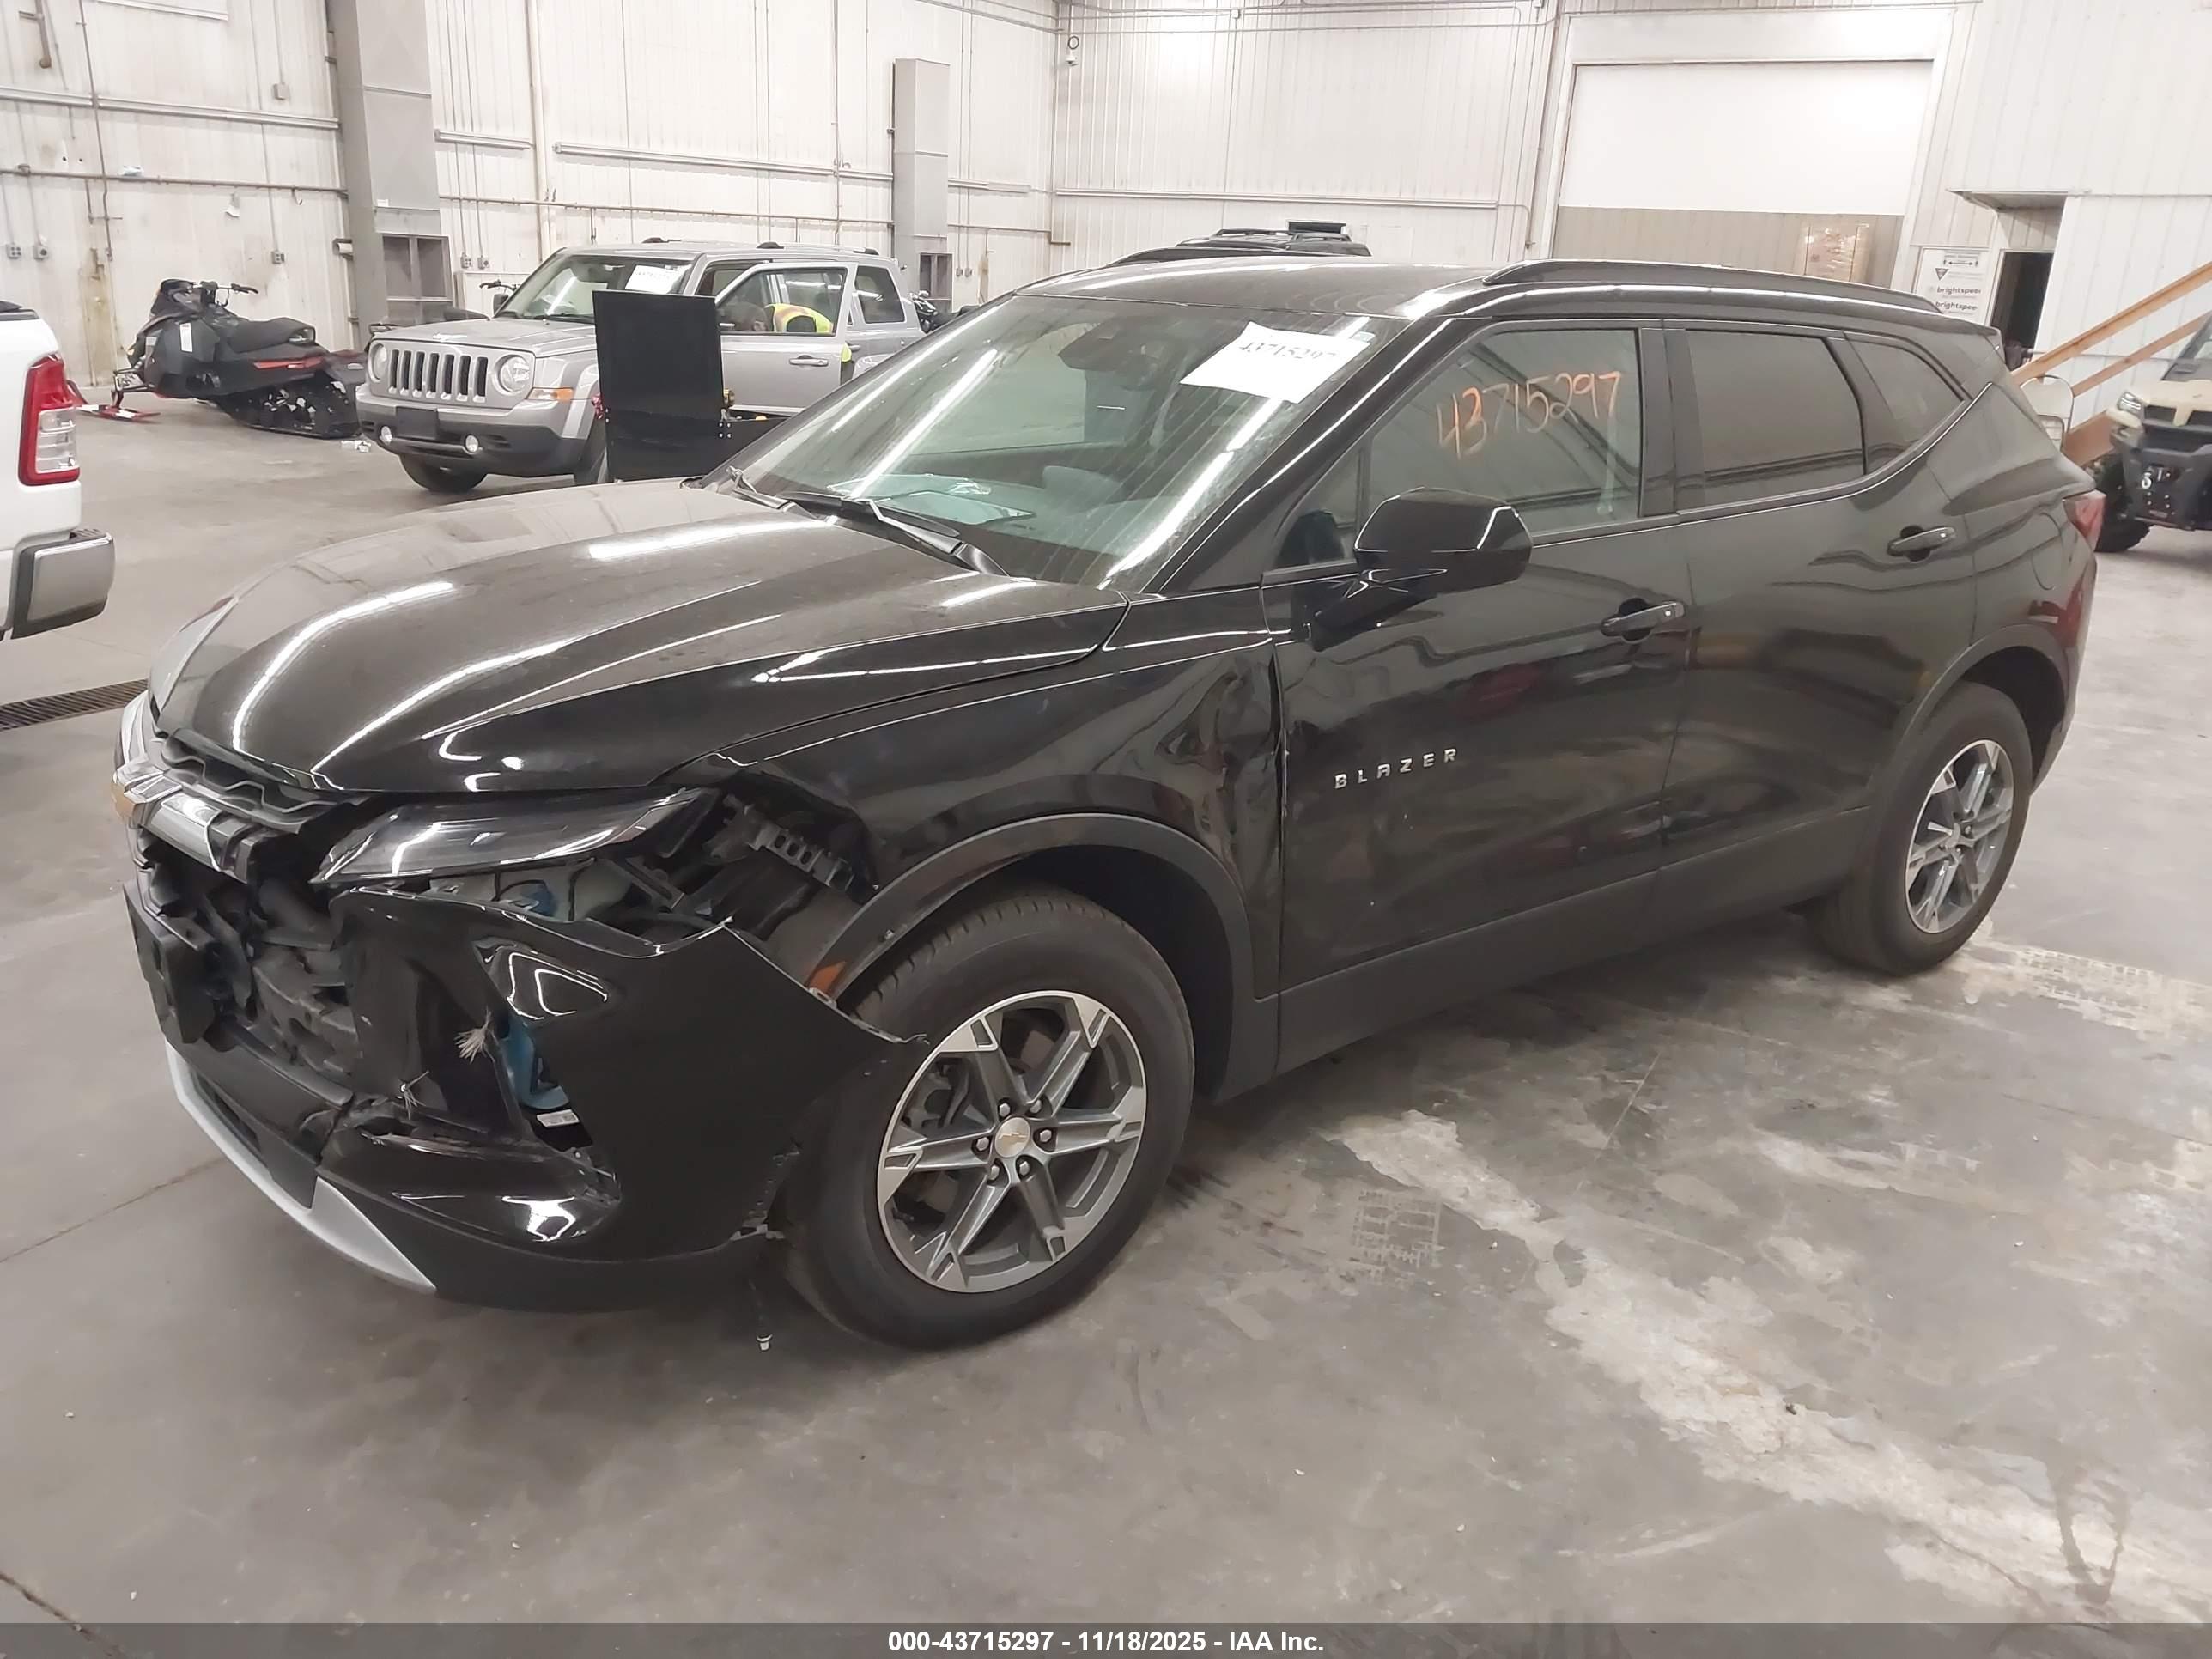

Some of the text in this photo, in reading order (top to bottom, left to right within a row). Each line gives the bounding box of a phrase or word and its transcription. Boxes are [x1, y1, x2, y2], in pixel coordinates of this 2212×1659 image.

[1936, 286, 1981, 295] brightspee
[1435, 370, 1621, 459] 43715297
[1334, 748, 1457, 789] BLAZER
